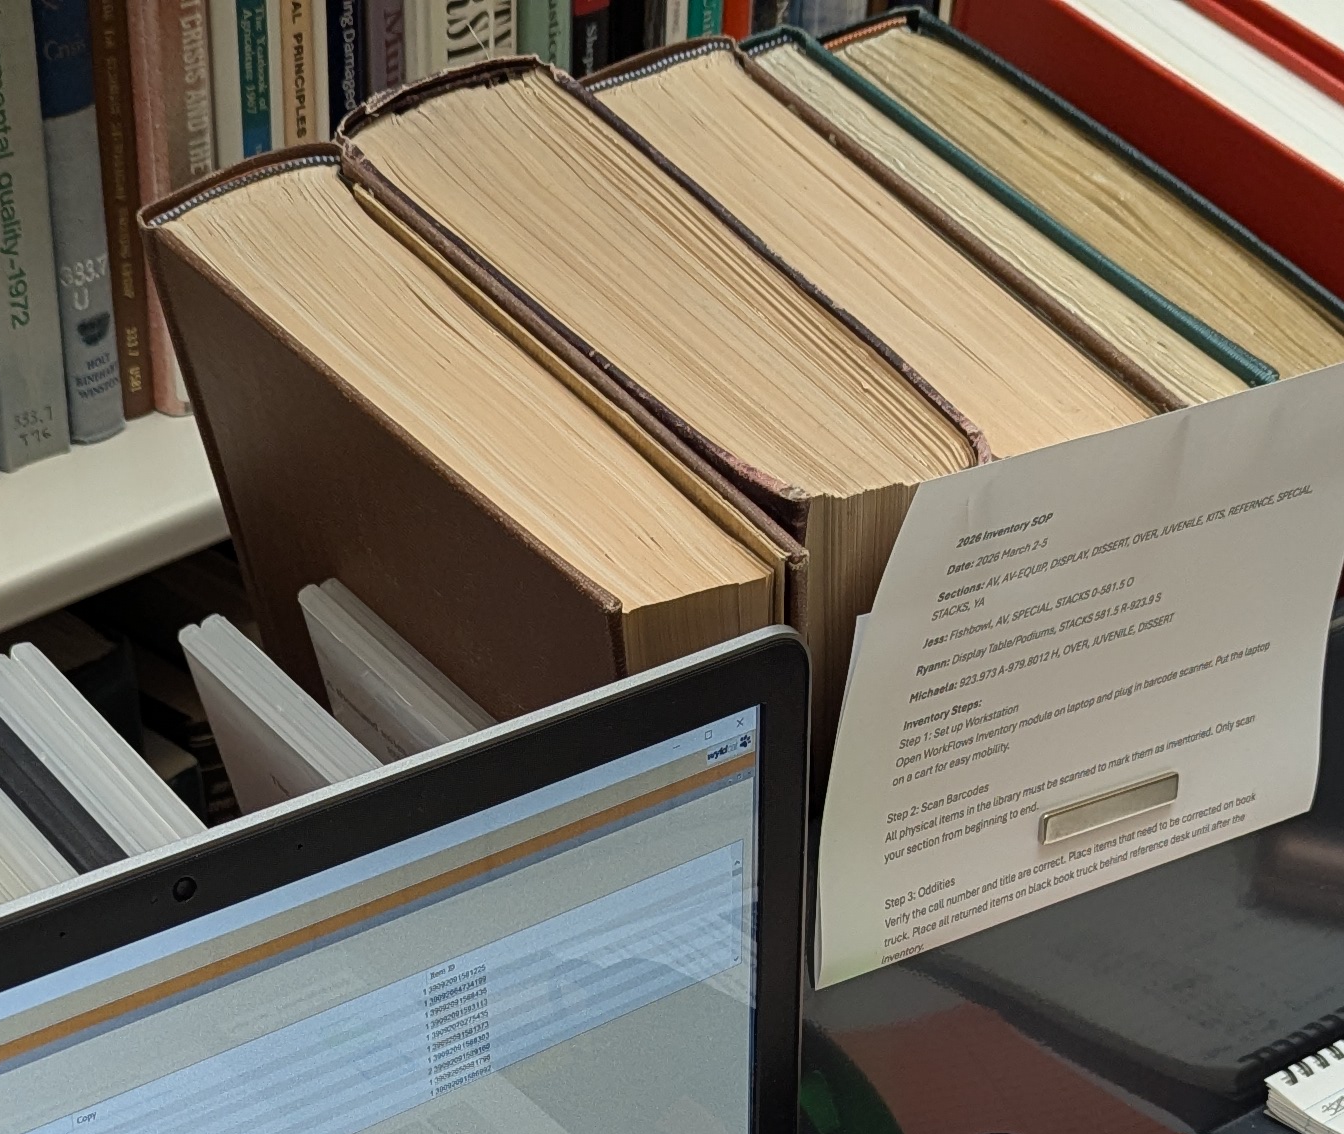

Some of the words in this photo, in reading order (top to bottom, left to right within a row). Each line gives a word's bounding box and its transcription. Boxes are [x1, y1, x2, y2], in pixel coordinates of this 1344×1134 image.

[181, 7, 204, 84] CRISIS
[254, 34, 269, 92] Yearbook
[293, 32, 307, 139] PRINCIPLES
[341, 30, 356, 111] Damaged
[184, 83, 207, 129] AND
[244, 83, 258, 114] 1967
[187, 131, 208, 176] THE
[937, 581, 986, 603] Sections:
[984, 576, 1001, 589] AV,
[1001, 563, 1049, 584] AV-EQUIP,
[1049, 551, 1090, 570] DISPLAY,
[1091, 540, 1130, 557] DISSERT,
[1132, 531, 1159, 545] OVER,
[1159, 519, 1204, 537] JUVENILE,
[1205, 512, 1226, 523] KITS,
[1227, 498, 1275, 517] REFERNCE,
[1276, 487, 1313, 503] SPECIAL,
[955, 533, 983, 549] 2026
[982, 520, 1031, 541] Inventory
[1030, 514, 1054, 527] SOP
[946, 560, 975, 576] Date:
[974, 552, 1001, 568] 2026
[1000, 544, 1032, 560] March
[1031, 538, 1049, 551] 2-5
[898, 735, 922, 750] Step
[923, 732, 933, 742] 1:
[933, 726, 950, 739] Set
[950, 722, 964, 735] up
[965, 704, 1020, 729] Workstation
[903, 709, 951, 731] Inventory
[950, 699, 983, 716] Steps:
[884, 895, 906, 910] Step
[907, 891, 916, 902] 3:
[917, 877, 956, 898] Oddities
